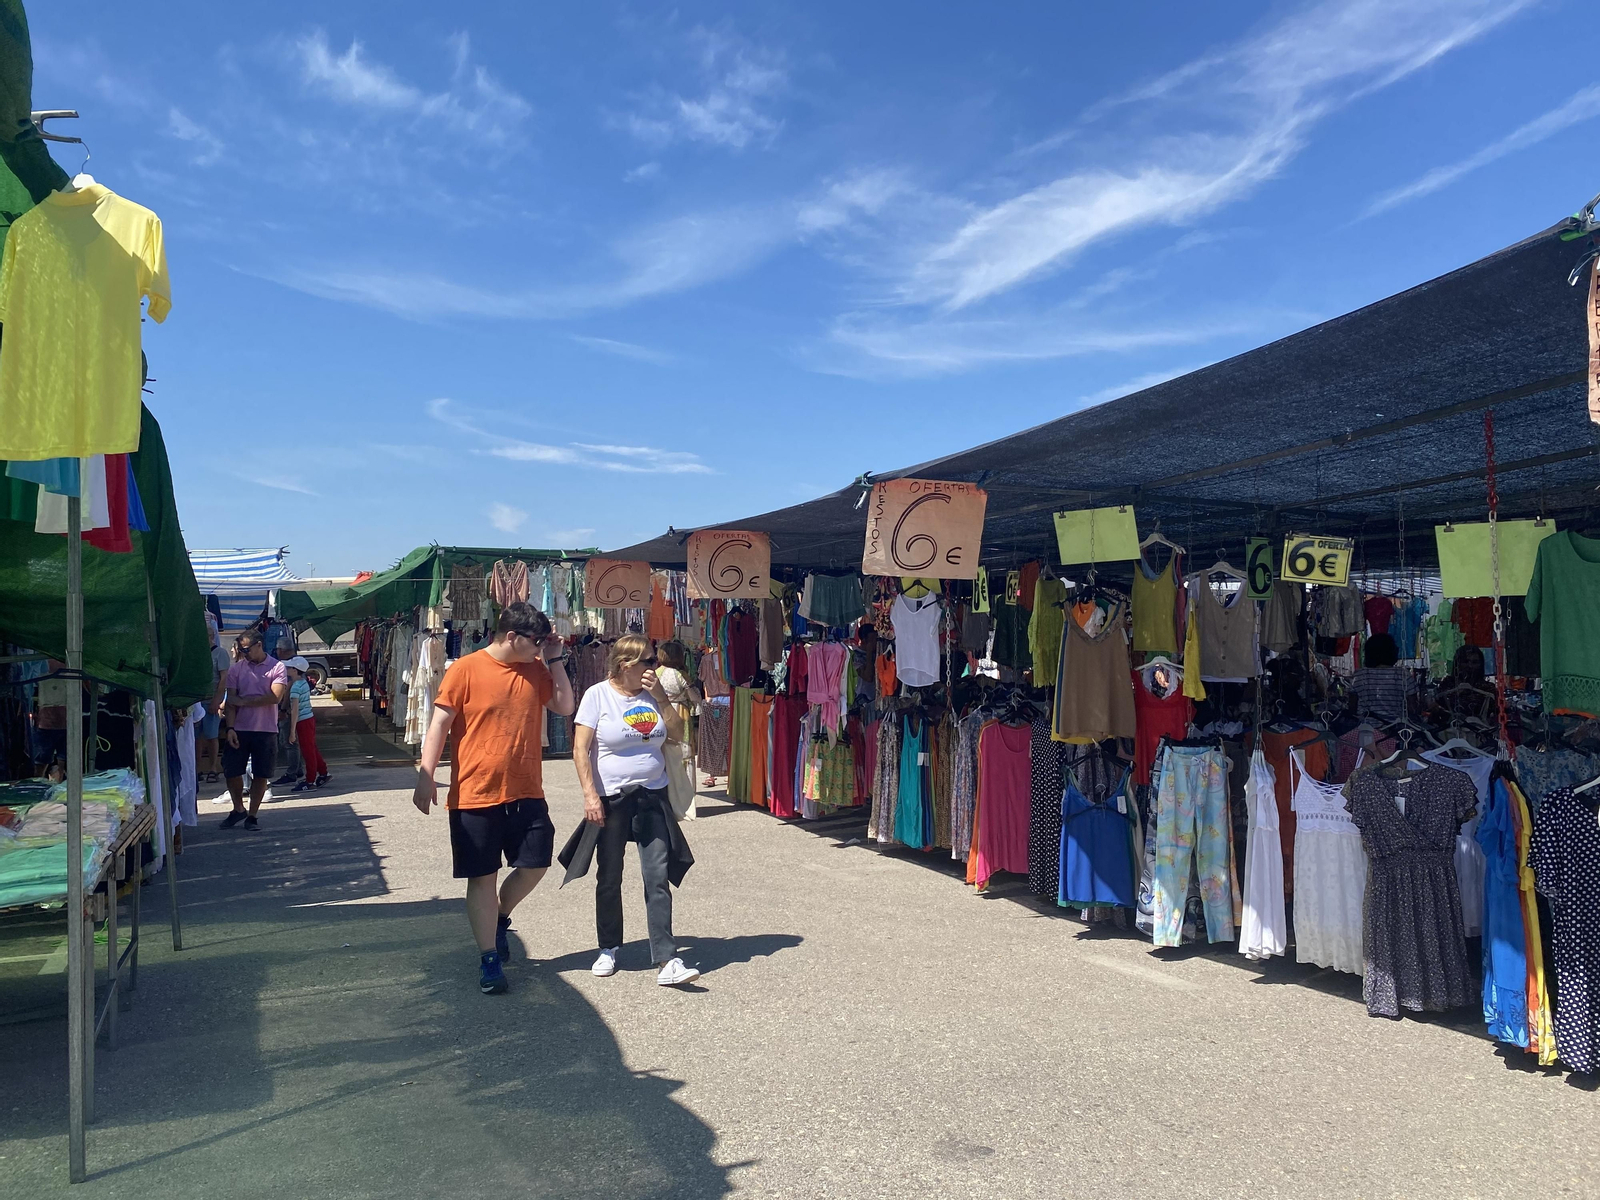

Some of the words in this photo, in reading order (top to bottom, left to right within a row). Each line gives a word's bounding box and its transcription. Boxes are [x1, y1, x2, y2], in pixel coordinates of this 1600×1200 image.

[909, 481, 970, 495] OFERTAS
[869, 481, 887, 554] RESTOS
[1288, 540, 1339, 577] 6€
